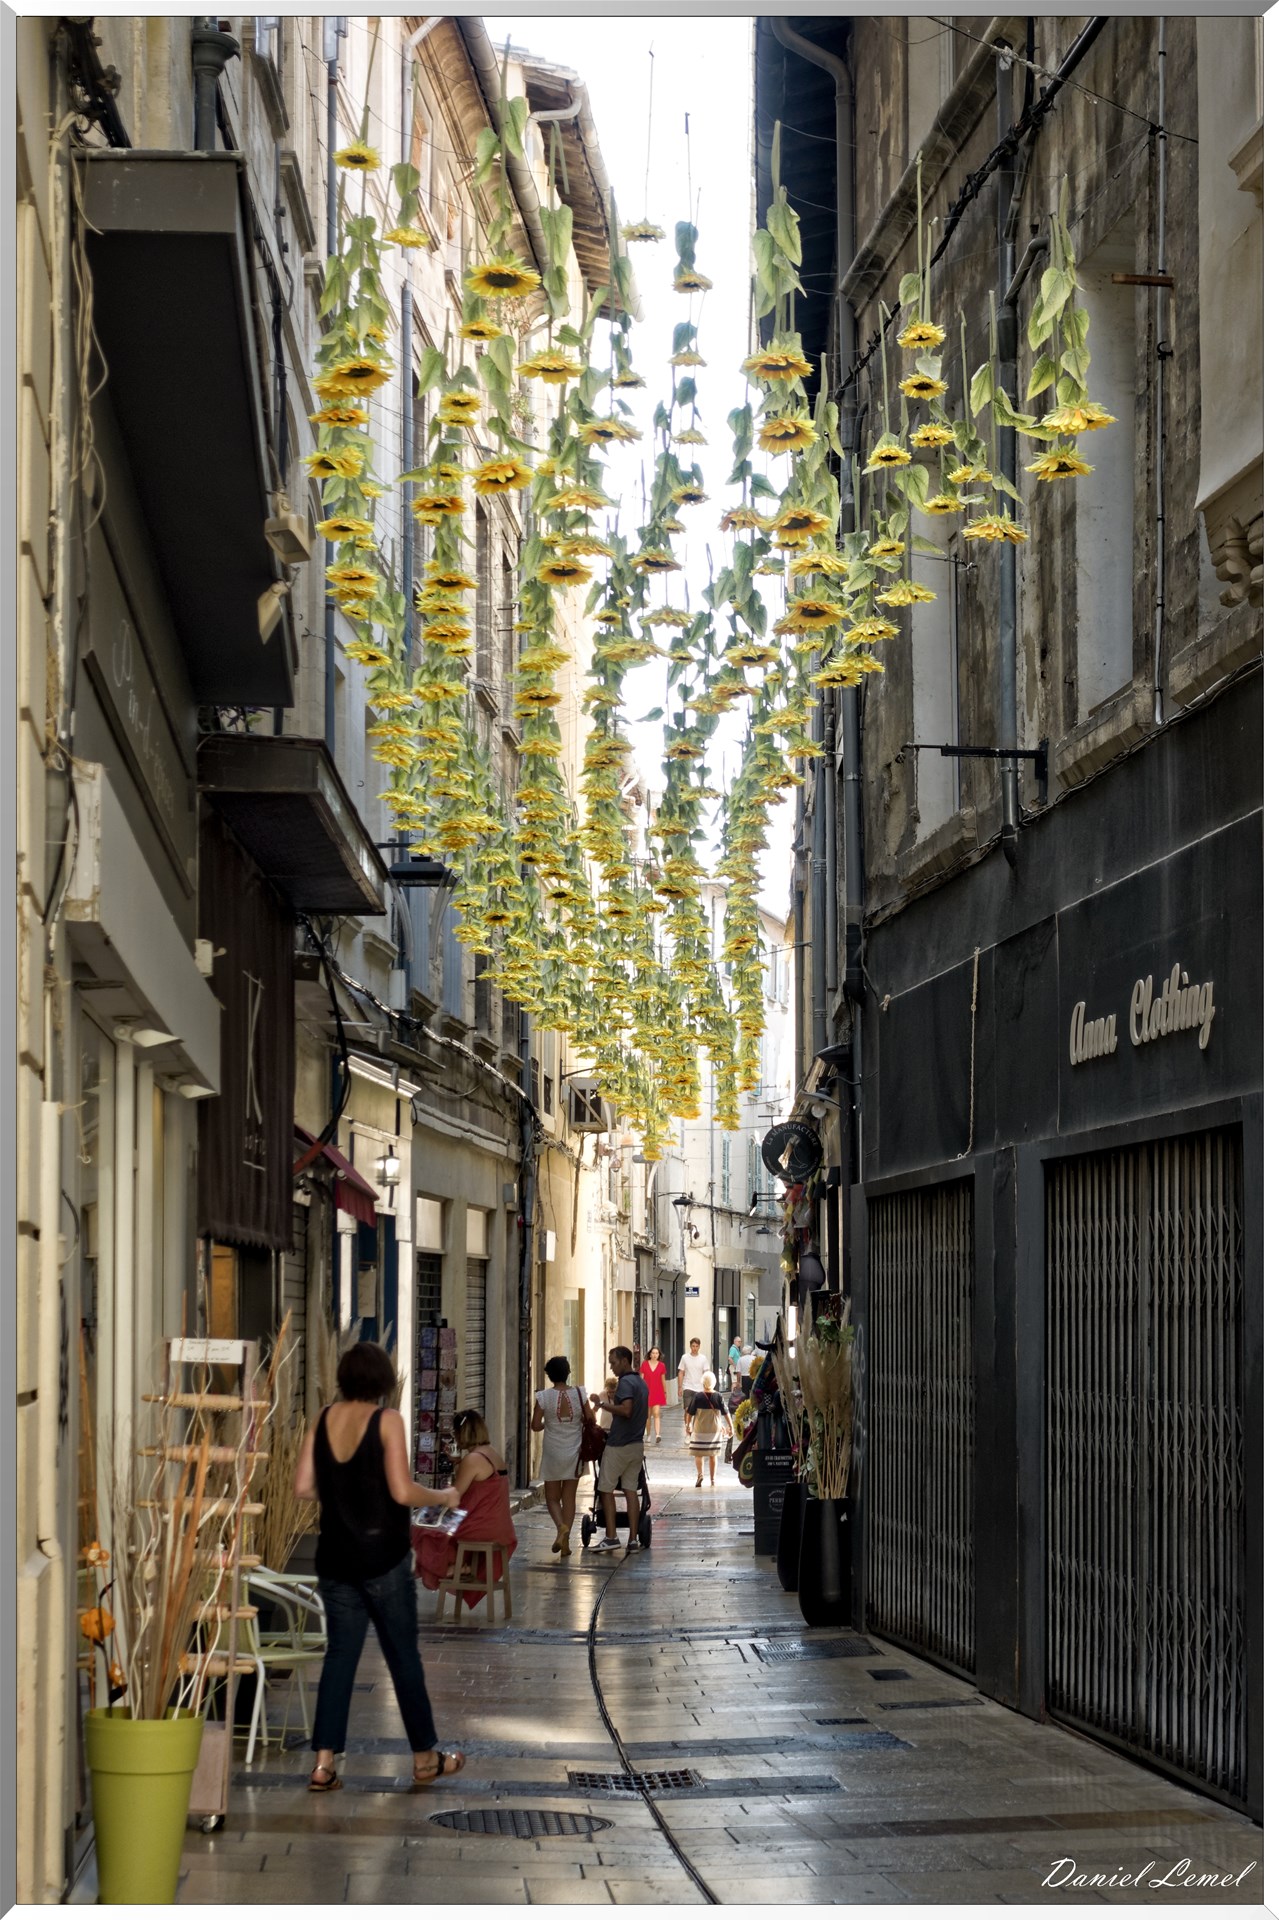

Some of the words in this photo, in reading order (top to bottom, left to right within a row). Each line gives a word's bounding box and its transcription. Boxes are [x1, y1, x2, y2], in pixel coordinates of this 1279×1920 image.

[1070, 1001, 1118, 1066] Anna
[1129, 962, 1216, 1050] Clothing
[771, 1123, 818, 1146] MANUFACTURE
